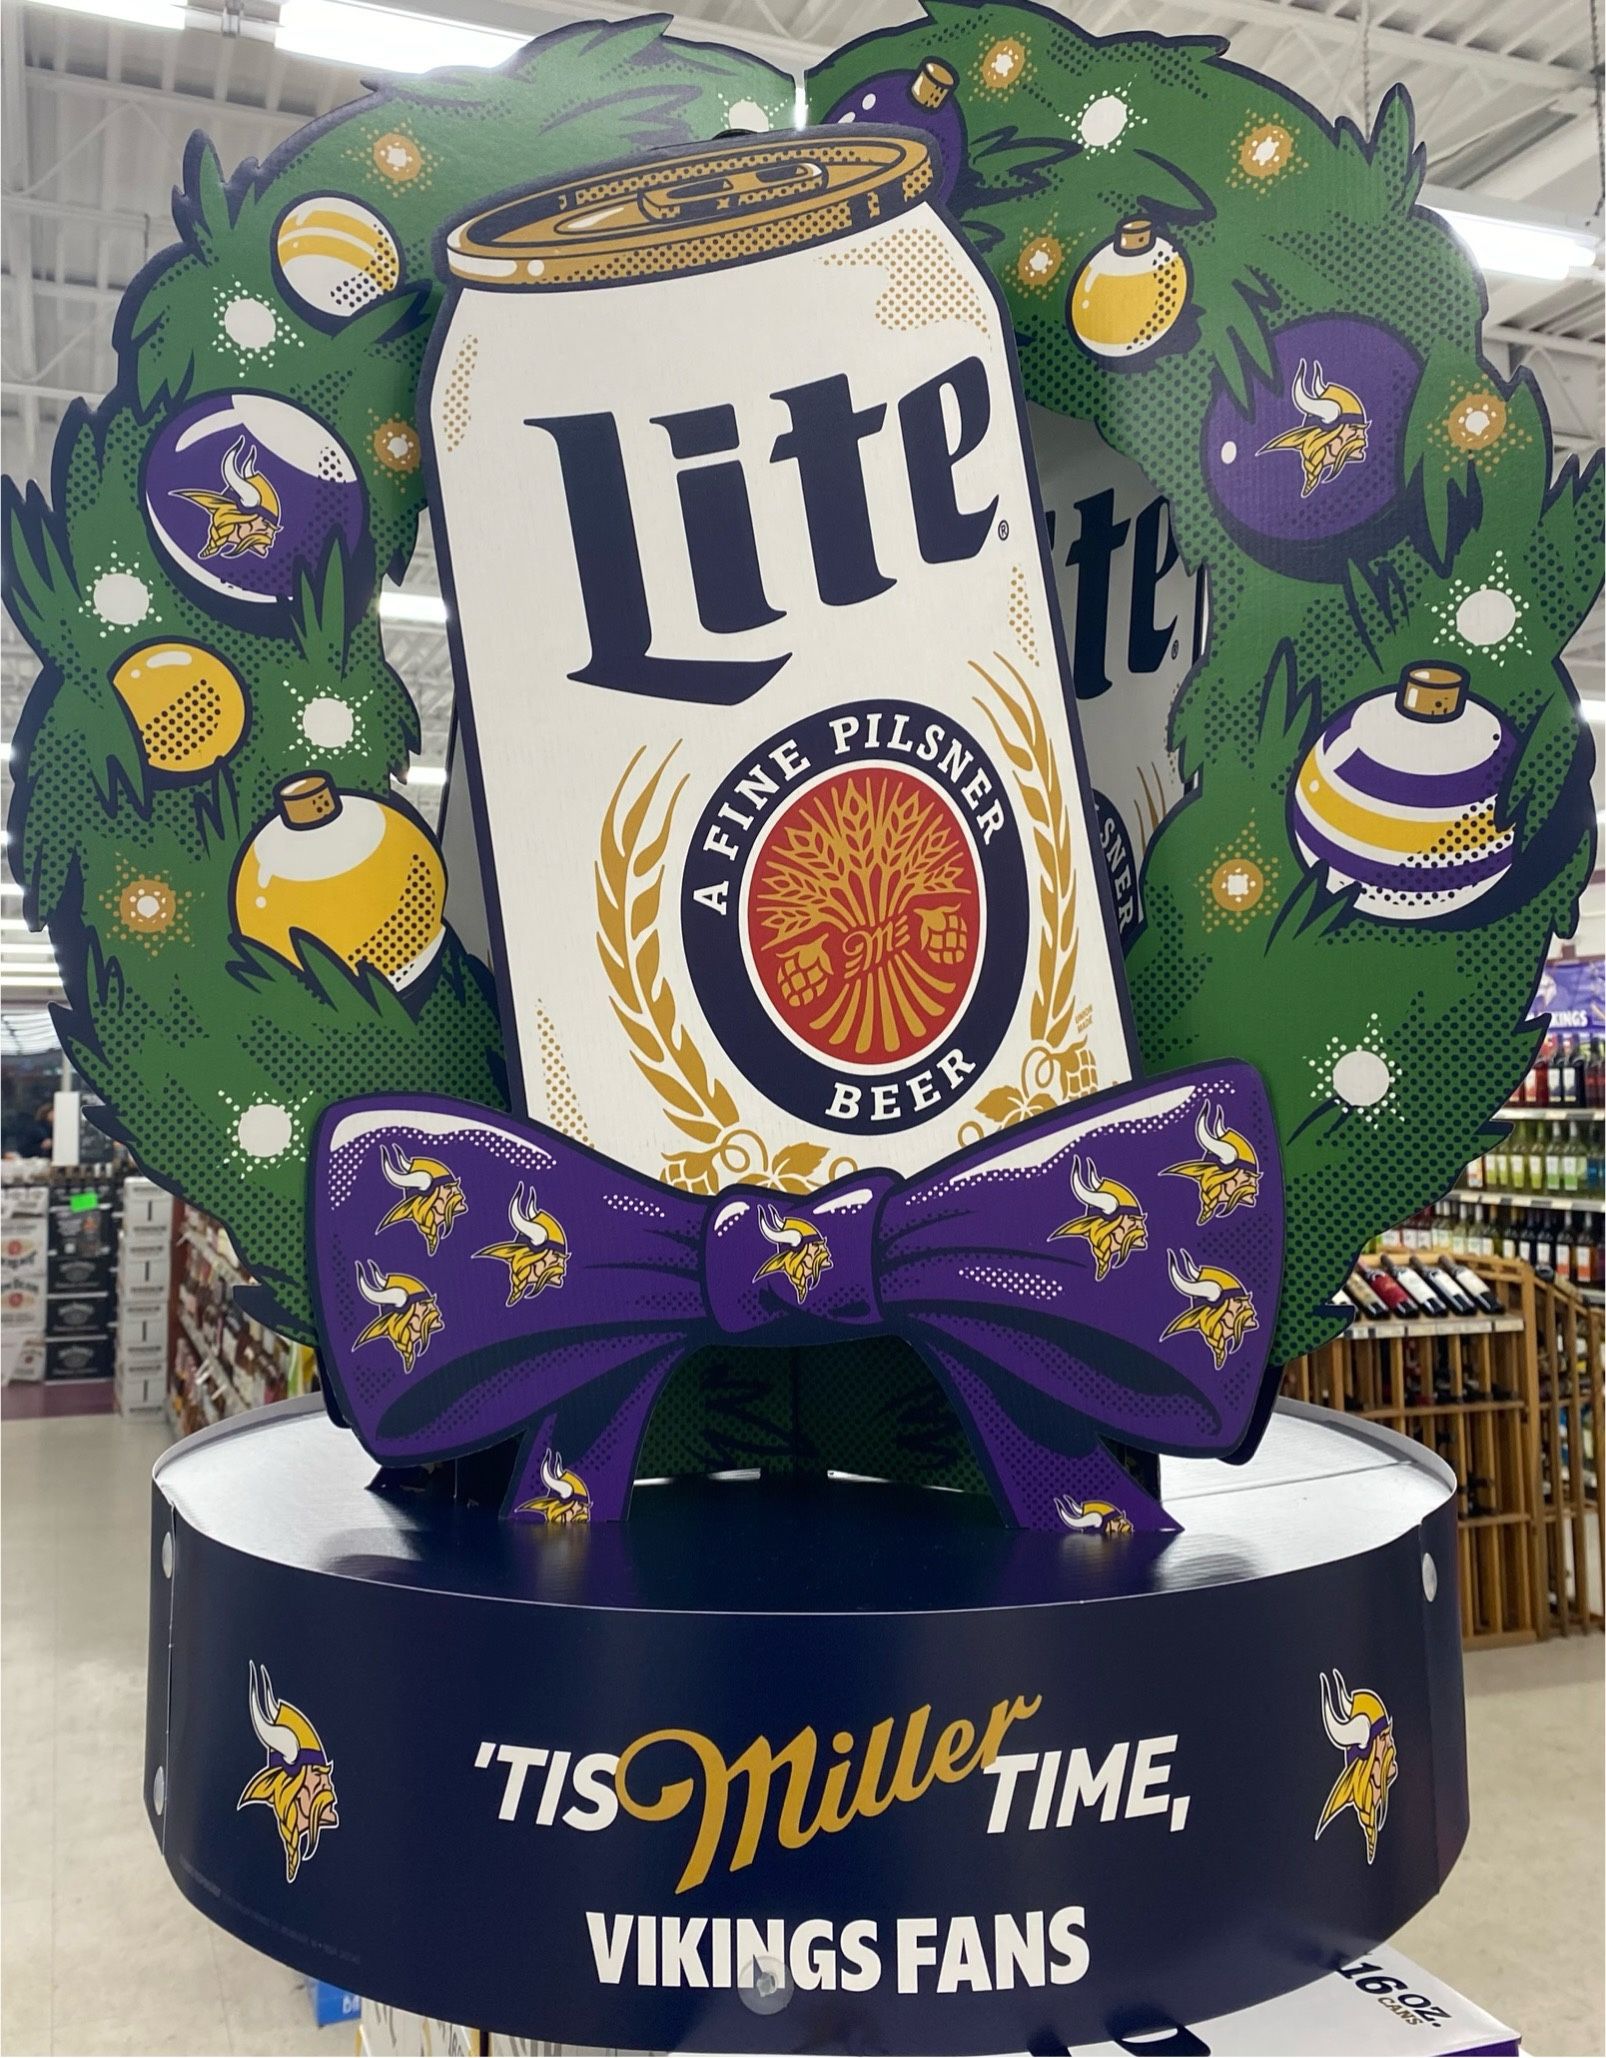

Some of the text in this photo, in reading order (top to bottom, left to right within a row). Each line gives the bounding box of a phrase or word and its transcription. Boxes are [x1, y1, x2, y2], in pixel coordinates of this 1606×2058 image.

[524, 356, 1000, 706] Lite
[692, 712, 1006, 916] A FINE PILSNER
[825, 1047, 977, 1121] BEER
[614, 1694, 1042, 1895] Miller
[983, 1734, 1191, 1833] TIME,
[585, 1905, 1090, 1994] VIKINGS FANS
[1336, 1962, 1453, 2028] 16 OZ.
[1377, 1996, 1424, 2026] CANS
